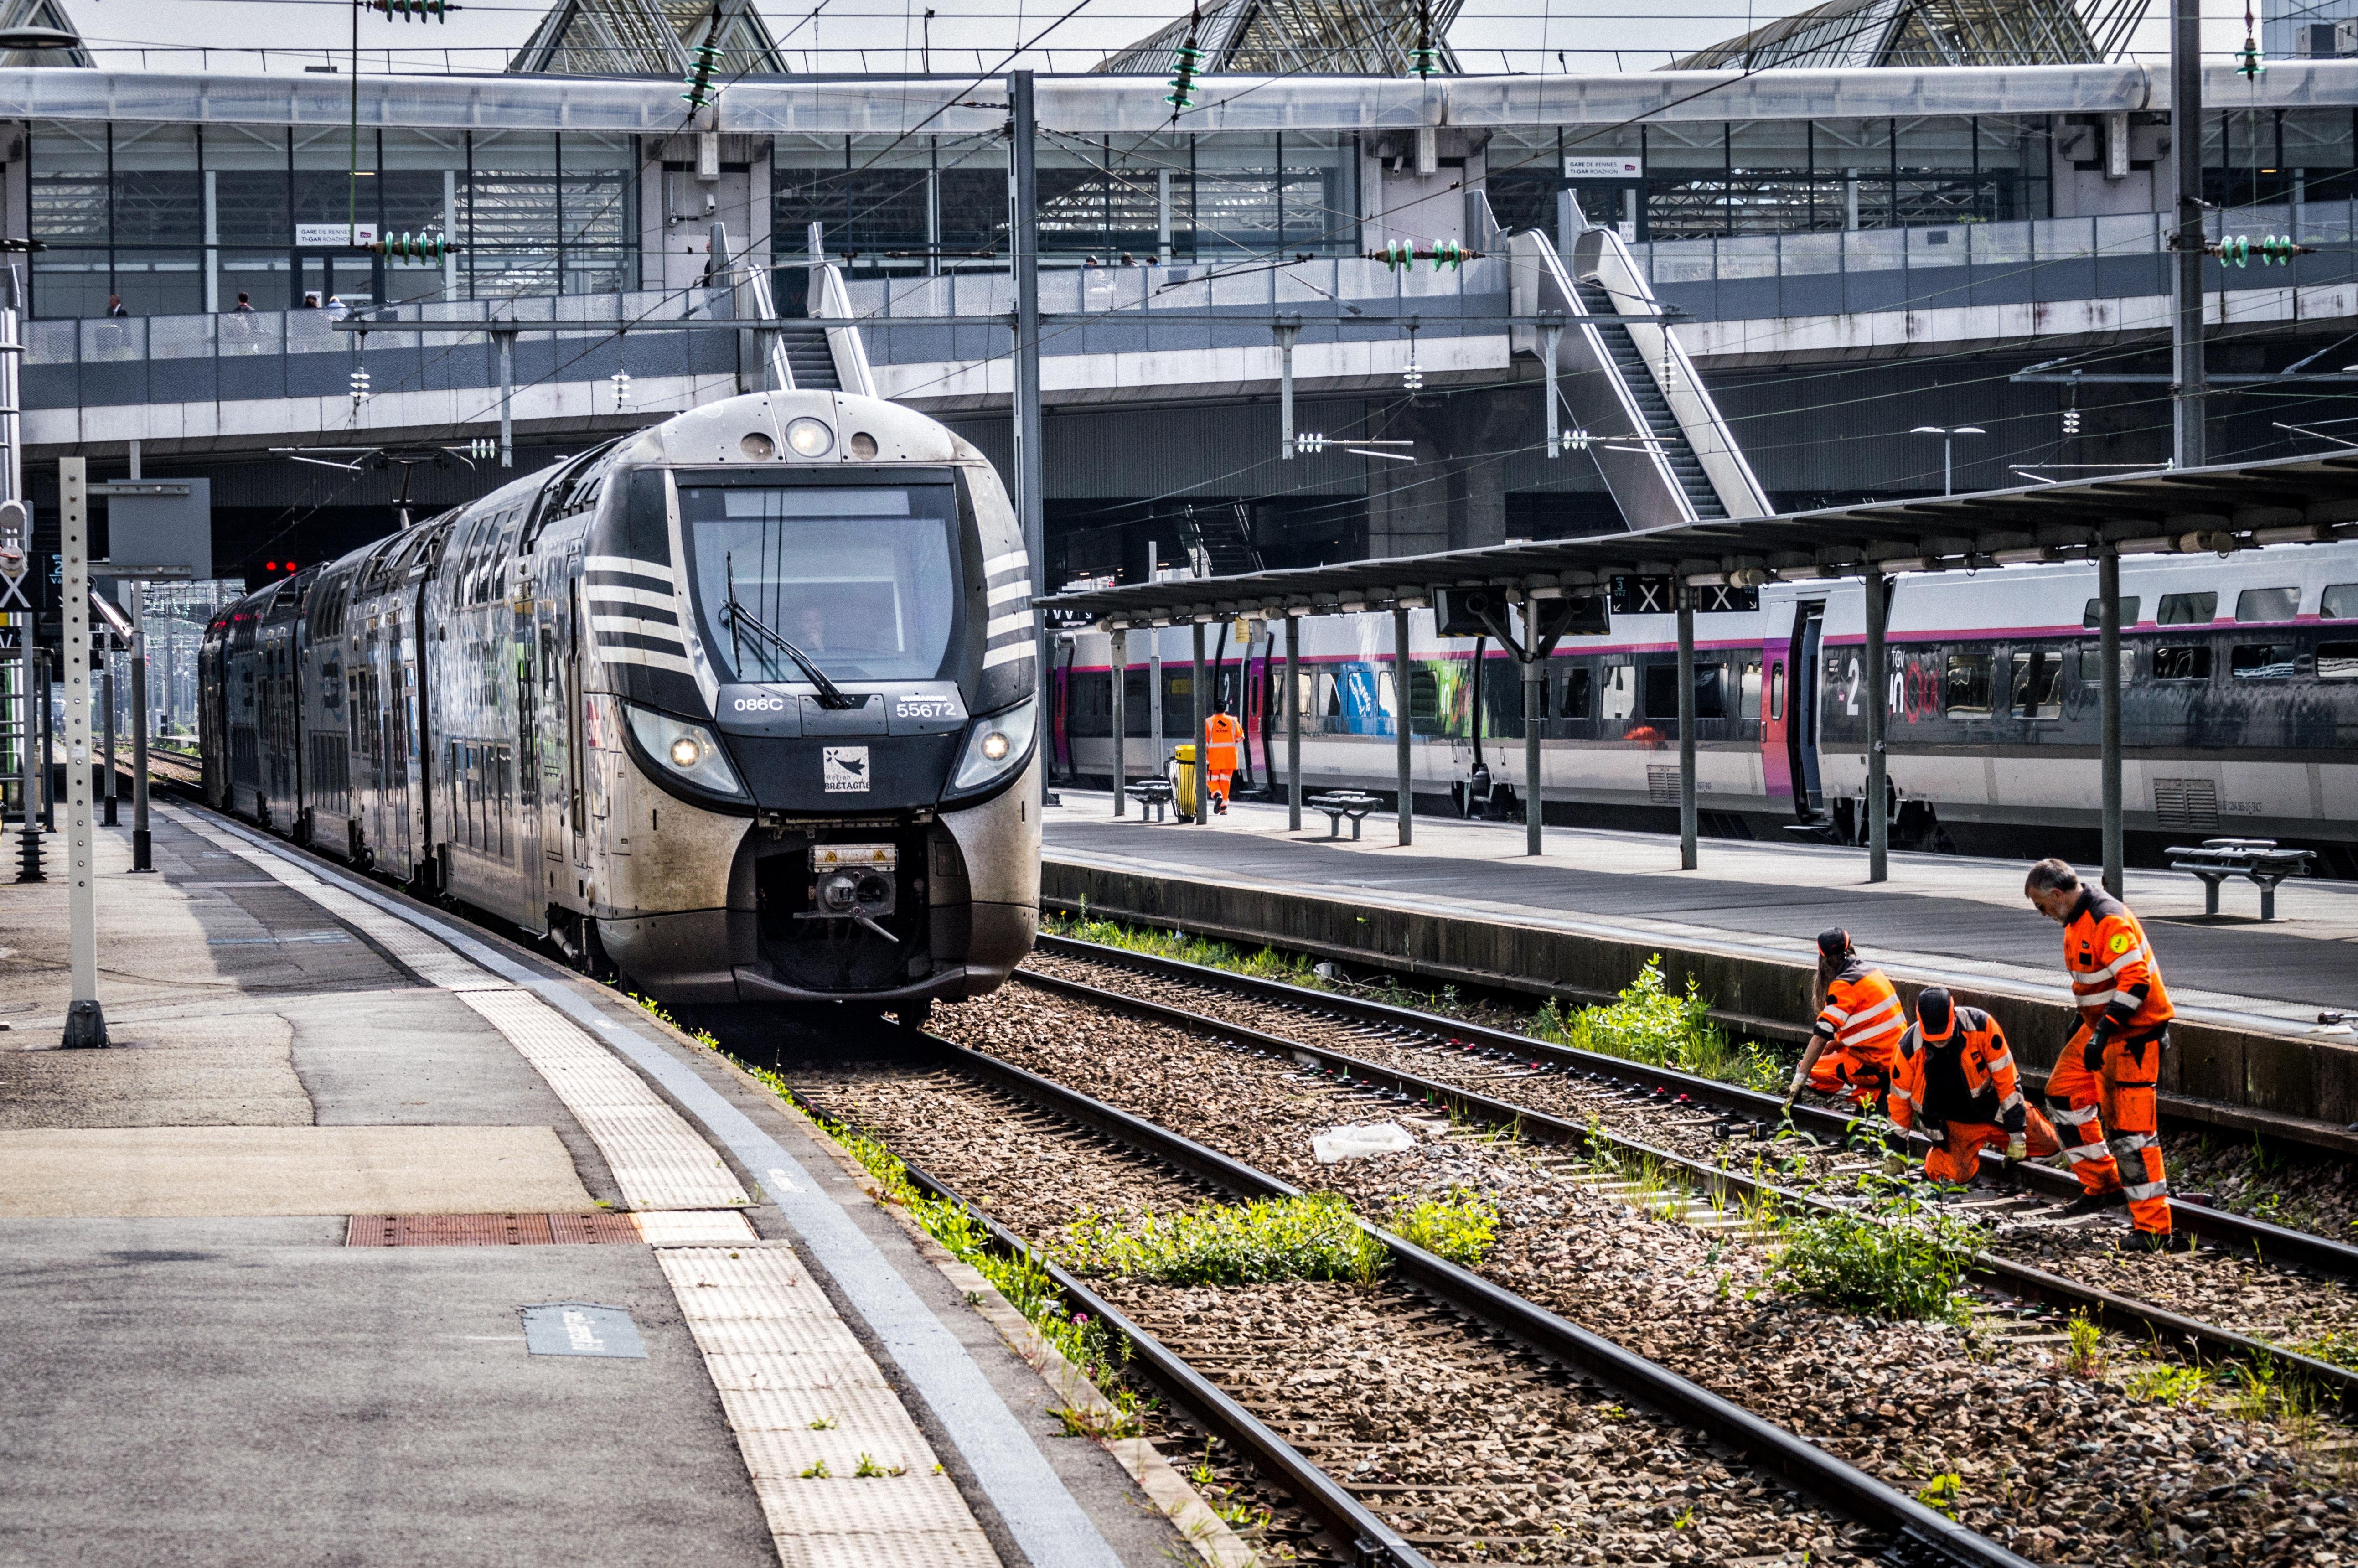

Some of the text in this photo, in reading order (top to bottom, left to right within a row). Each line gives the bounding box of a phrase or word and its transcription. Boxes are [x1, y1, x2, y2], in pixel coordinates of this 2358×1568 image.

[55, 561, 63, 574] 2
[0, 568, 32, 608] X
[1617, 581, 1623, 590] 3
[1639, 584, 1660, 611] X
[1711, 585, 1732, 610] X
[1891, 650, 1905, 668] TGV
[1224, 673, 1230, 712] 2
[1847, 658, 1859, 715] 2
[734, 698, 783, 711] 086C
[896, 703, 957, 718] 55672
